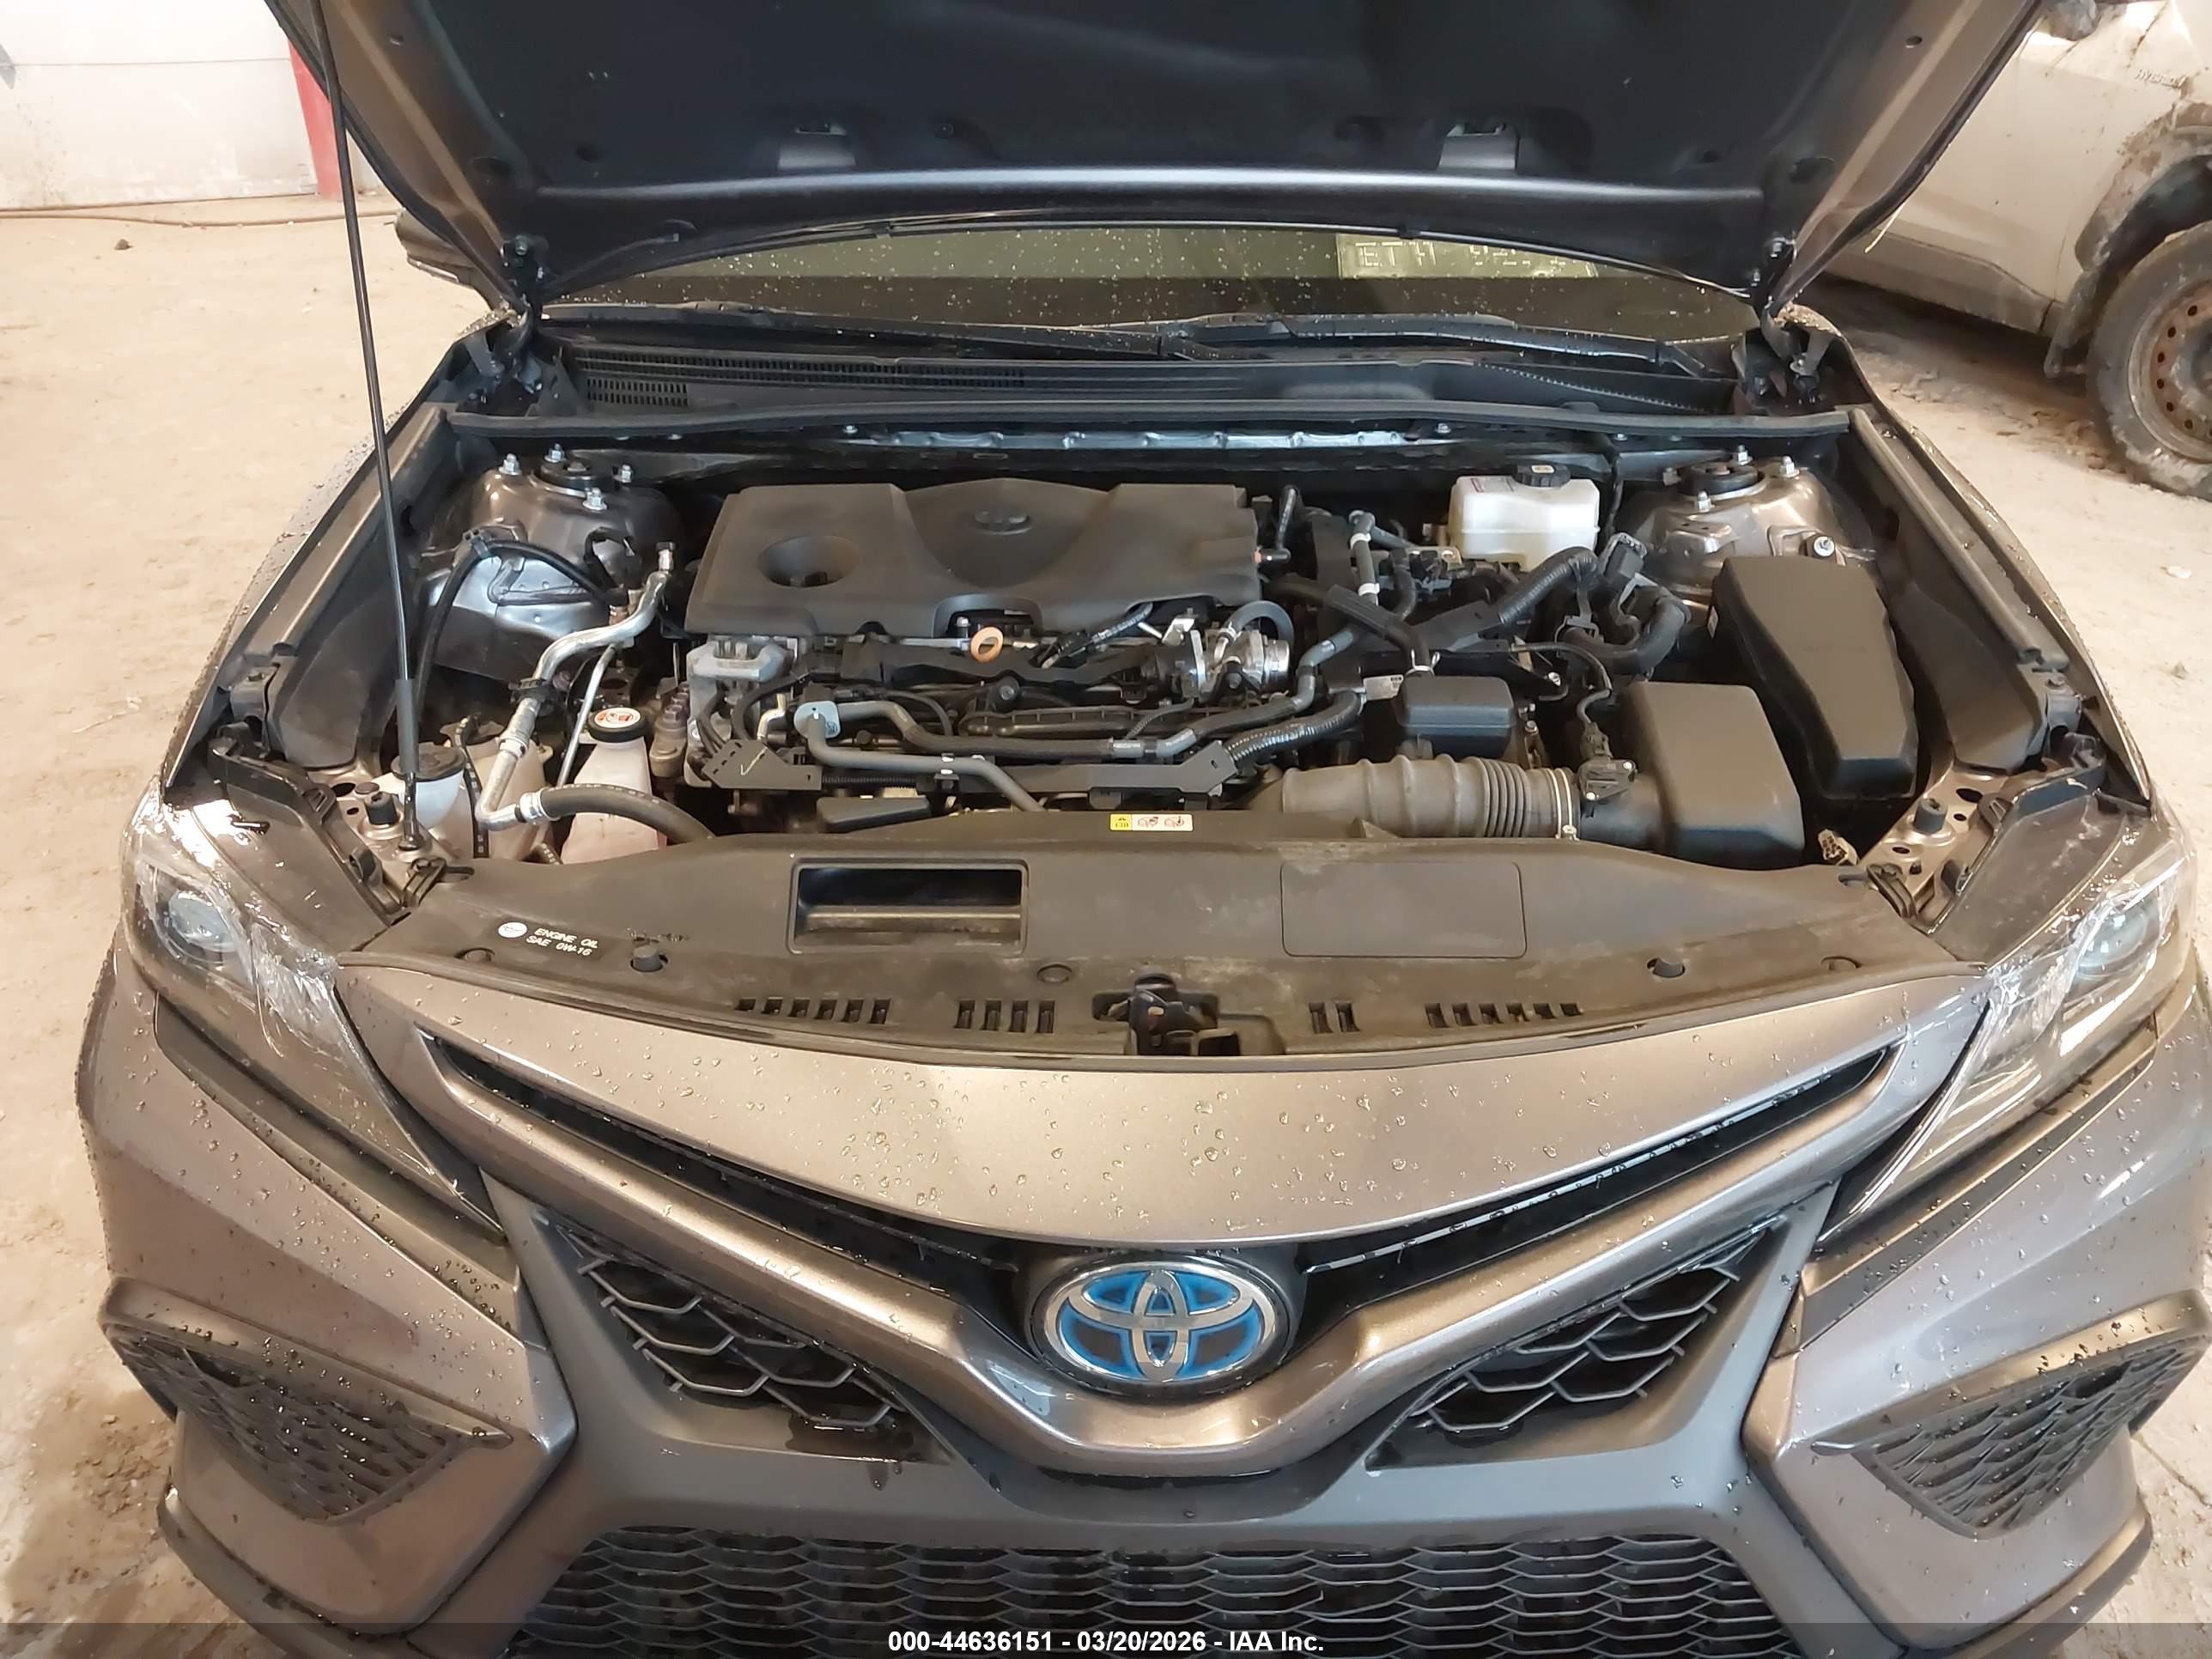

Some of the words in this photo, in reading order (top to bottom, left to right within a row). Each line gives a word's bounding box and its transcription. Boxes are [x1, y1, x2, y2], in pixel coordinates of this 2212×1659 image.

[526, 935, 552, 947] SAE
[556, 942, 592, 957] 0W-16
[534, 927, 577, 944] ENGINE
[580, 938, 599, 949] OIL
